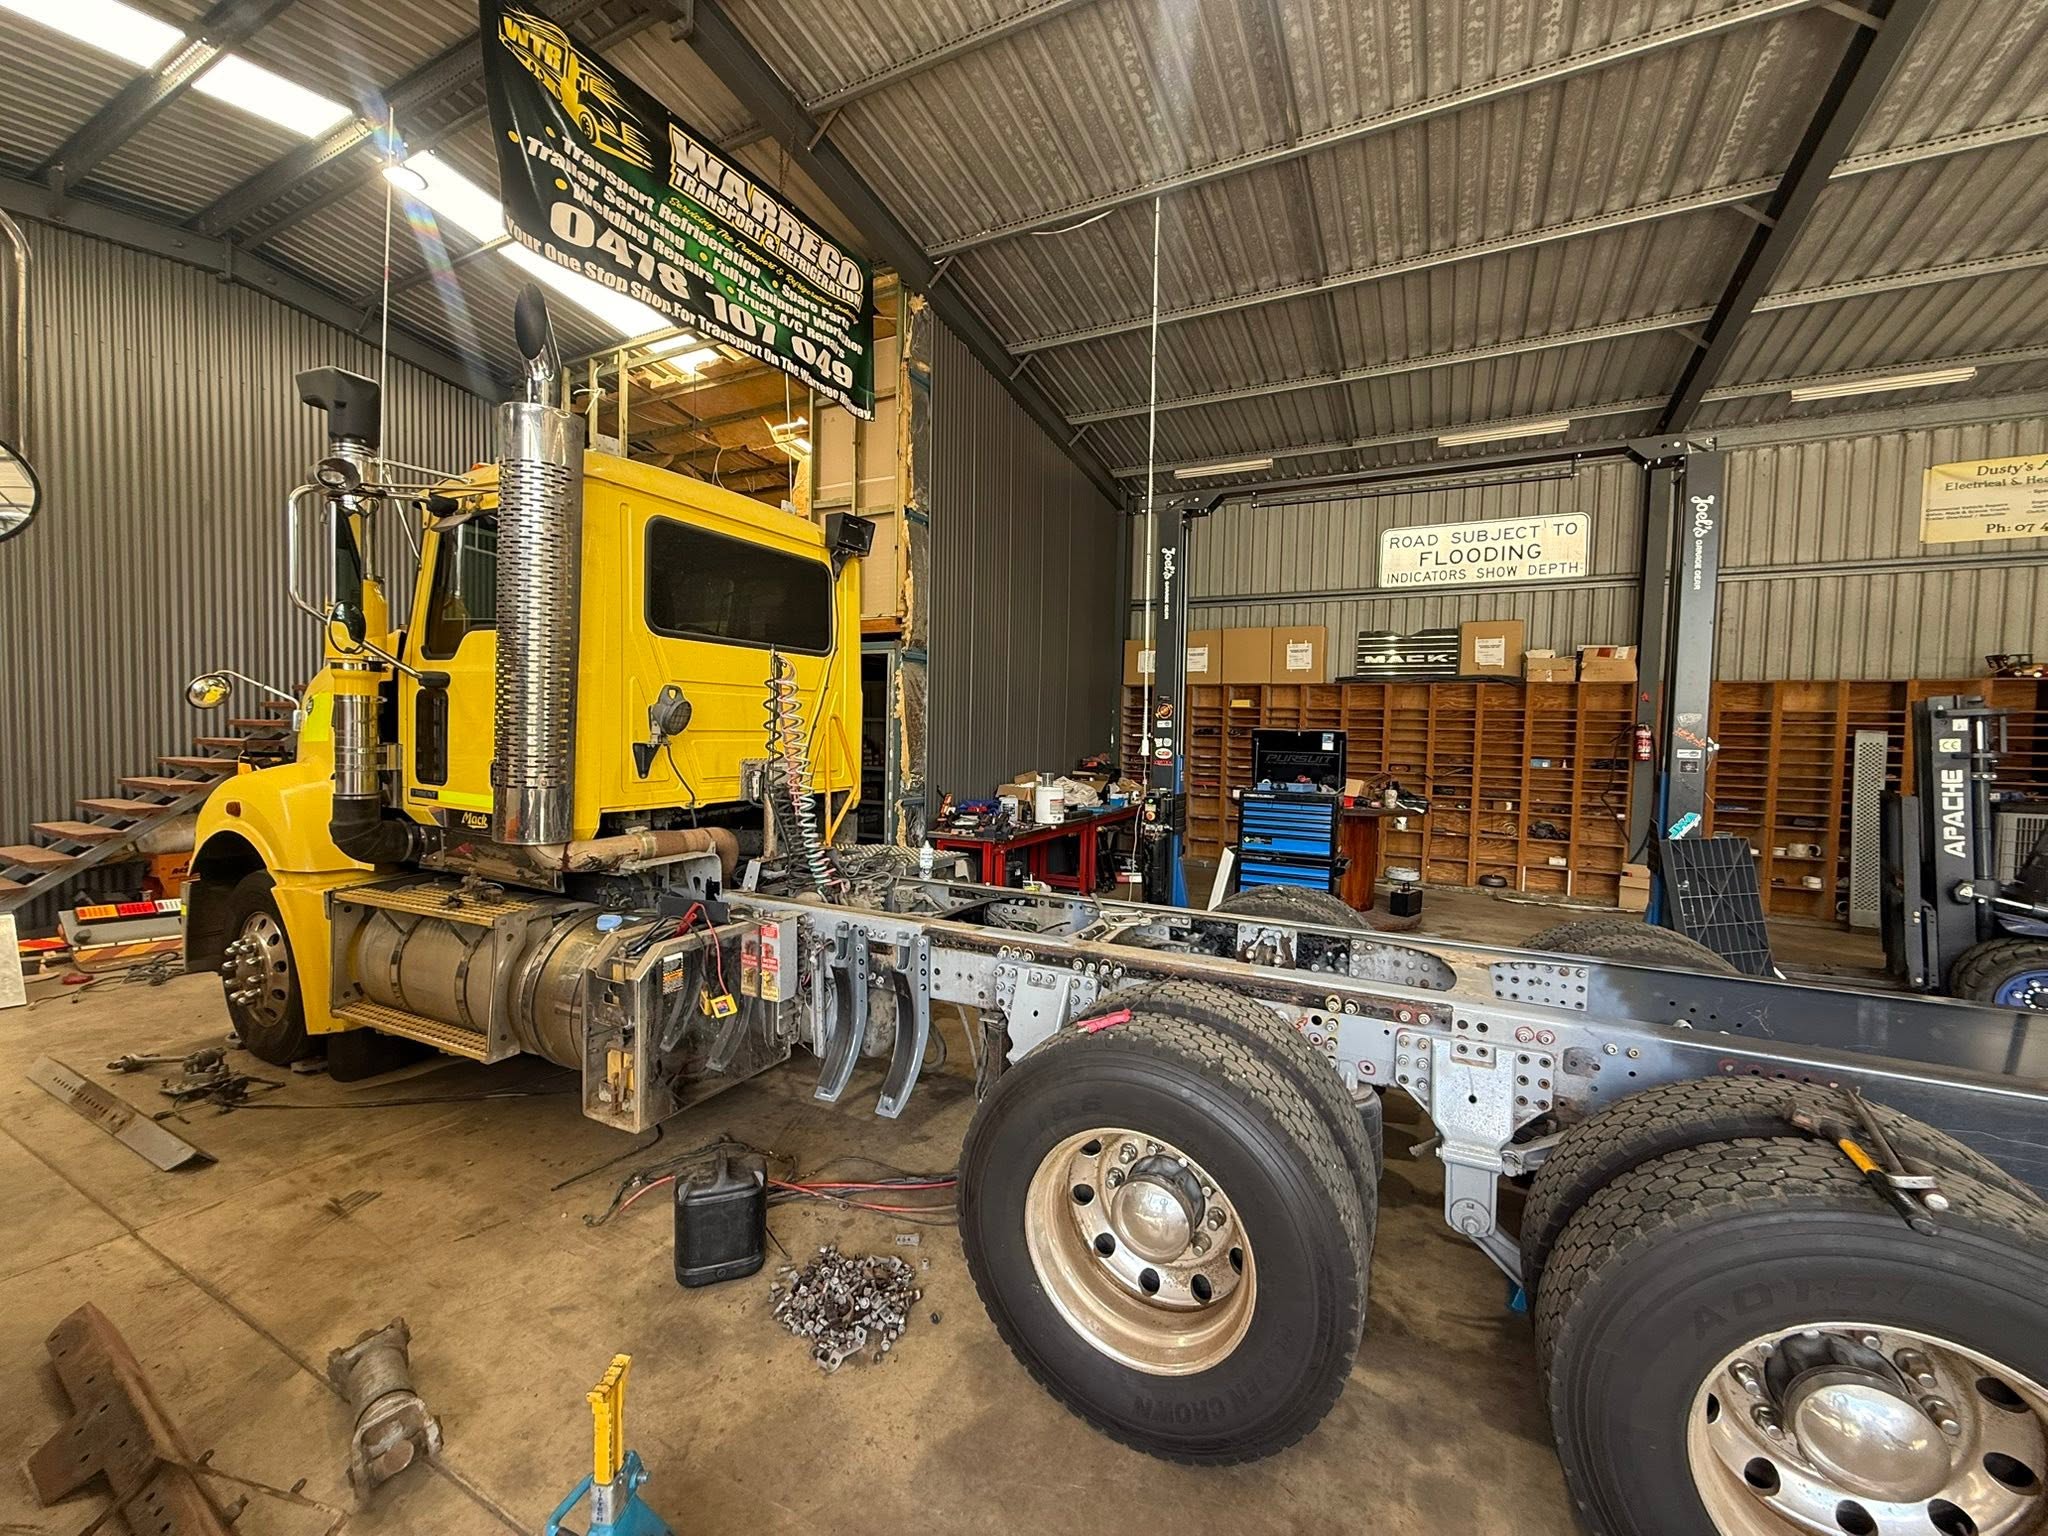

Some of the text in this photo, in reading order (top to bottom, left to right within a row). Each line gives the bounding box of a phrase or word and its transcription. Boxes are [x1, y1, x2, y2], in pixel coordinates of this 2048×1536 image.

[526, 136, 686, 250] Trailer Servicing
[562, 136, 761, 278] Transport Refrigeration
[671, 125, 862, 293] WARREGO
[572, 182, 715, 285] Welding Repairs
[669, 196, 715, 231] Servicing
[716, 227, 734, 243] The
[734, 240, 778, 271] Transport
[775, 267, 784, 276] &
[674, 167, 861, 308] TRANSPORT & REFRIGERATION
[506, 214, 542, 254] Your
[544, 242, 581, 273] One
[584, 260, 628, 293] Stop
[674, 303, 697, 326] For
[698, 314, 763, 358] Transport
[763, 347, 780, 367] On
[800, 367, 839, 400] Warrego
[551, 202, 853, 389] 0478 107 049
[712, 256, 747, 288] Fully
[750, 279, 810, 325] Equipped
[782, 284, 819, 315] Spare
[736, 288, 775, 319] Truck
[779, 315, 804, 334] A/C
[1945, 479, 2007, 491] Electrical
[2010, 477, 2023, 486] &
[1976, 461, 2033, 476] Dusty's
[1690, 494, 1715, 538] Joel's
[1986, 523, 2010, 534] Ph:
[2014, 523, 2035, 533] 07
[1389, 522, 1578, 549] ROAD SUBJECT TO
[1161, 547, 1176, 580] Joel's
[1387, 562, 1579, 585] INDICATORS SHOW DEPTH
[1419, 543, 1542, 567] FLOODING
[1693, 569, 1702, 590] GEAR
[1364, 654, 1449, 664] MACK
[1265, 753, 1335, 764] PURSUIT
[461, 811, 489, 829] Mack
[1940, 769, 1966, 859] APACHE
